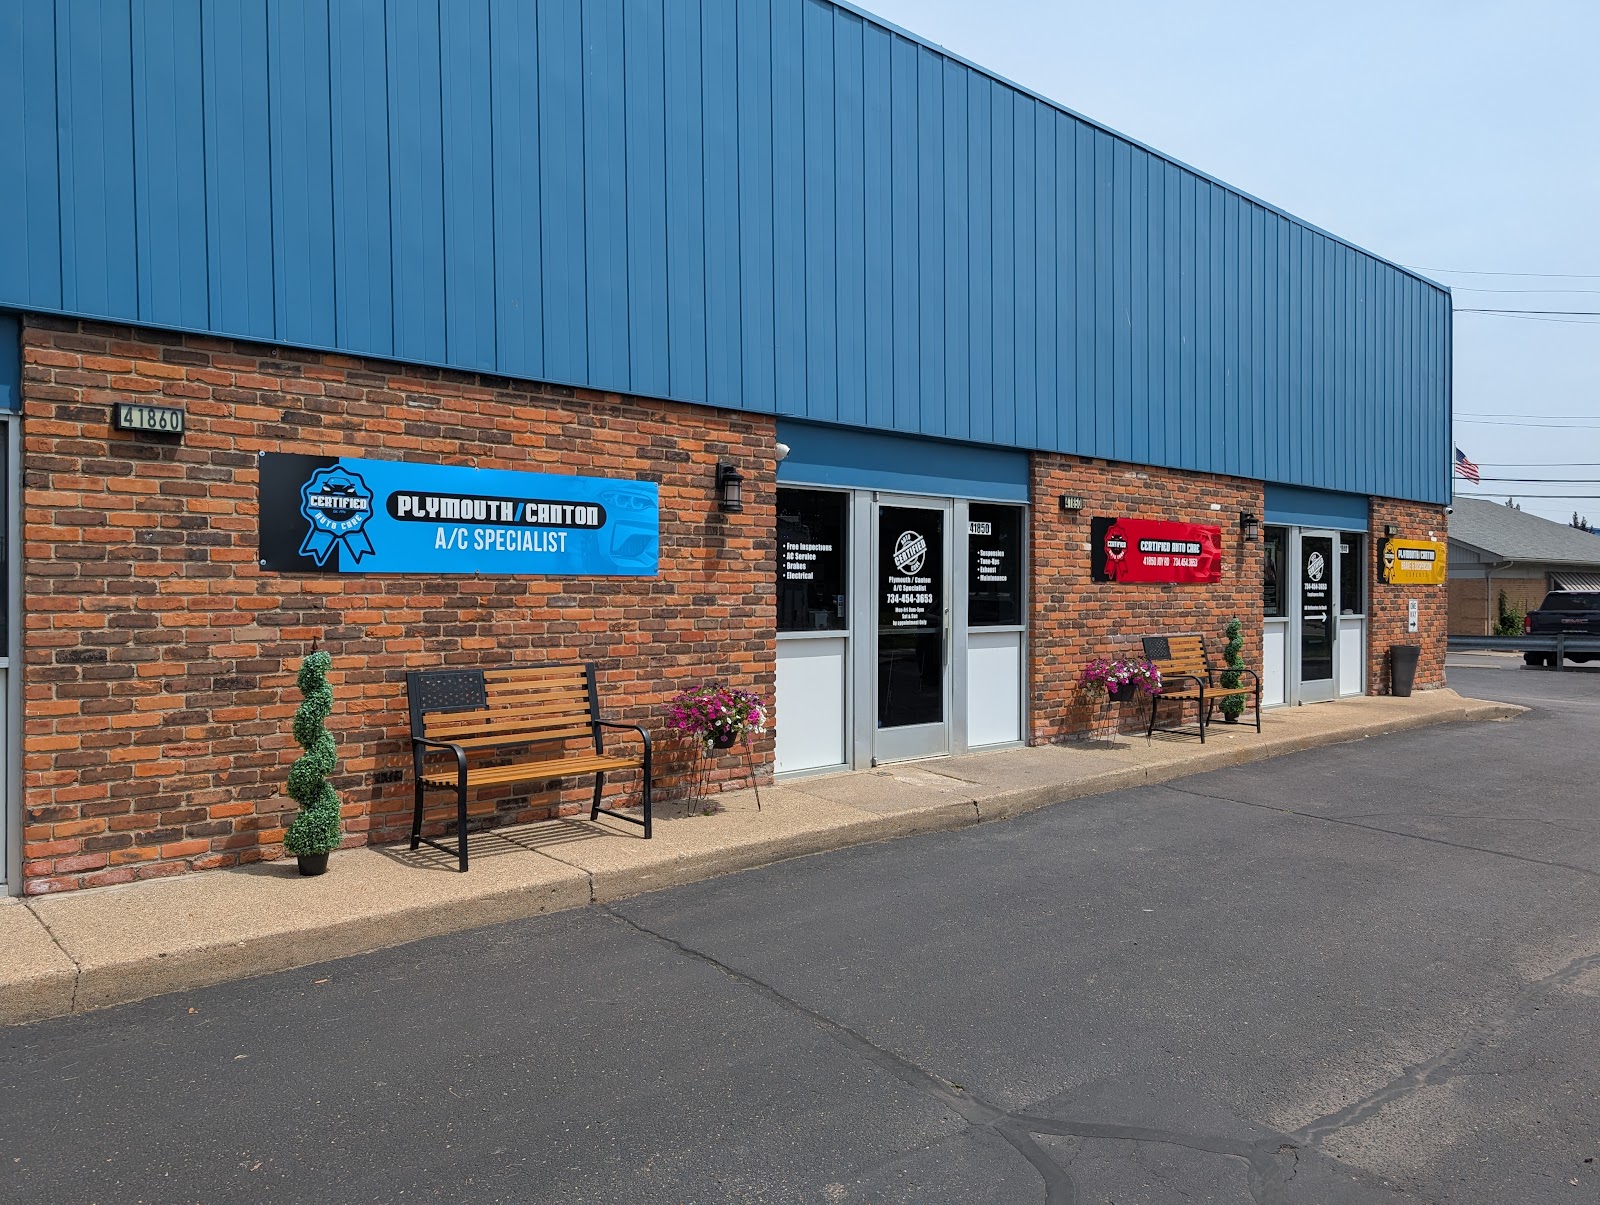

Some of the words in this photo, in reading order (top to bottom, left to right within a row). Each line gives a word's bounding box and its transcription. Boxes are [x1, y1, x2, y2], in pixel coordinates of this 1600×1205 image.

[123, 406, 179, 430] 41860
[310, 495, 367, 509] CERTIFIED
[315, 512, 337, 530] AUTO
[341, 514, 362, 530] CARE
[970, 522, 990, 534] 41850
[434, 527, 468, 550] A/C
[473, 528, 568, 552] SPECIALIST
[786, 542, 799, 550] Free
[800, 543, 832, 551] Inspections
[894, 539, 927, 566] CERTIFIED
[1140, 541, 1170, 552] CERTIFIED
[1171, 543, 1186, 553] AUTO
[1187, 544, 1200, 554] CARE
[786, 552, 794, 560] AC
[795, 552, 816, 560] Service
[786, 562, 806, 570] Brakes
[888, 576, 911, 584] Plymouth
[887, 594, 932, 604] 734-454-3653
